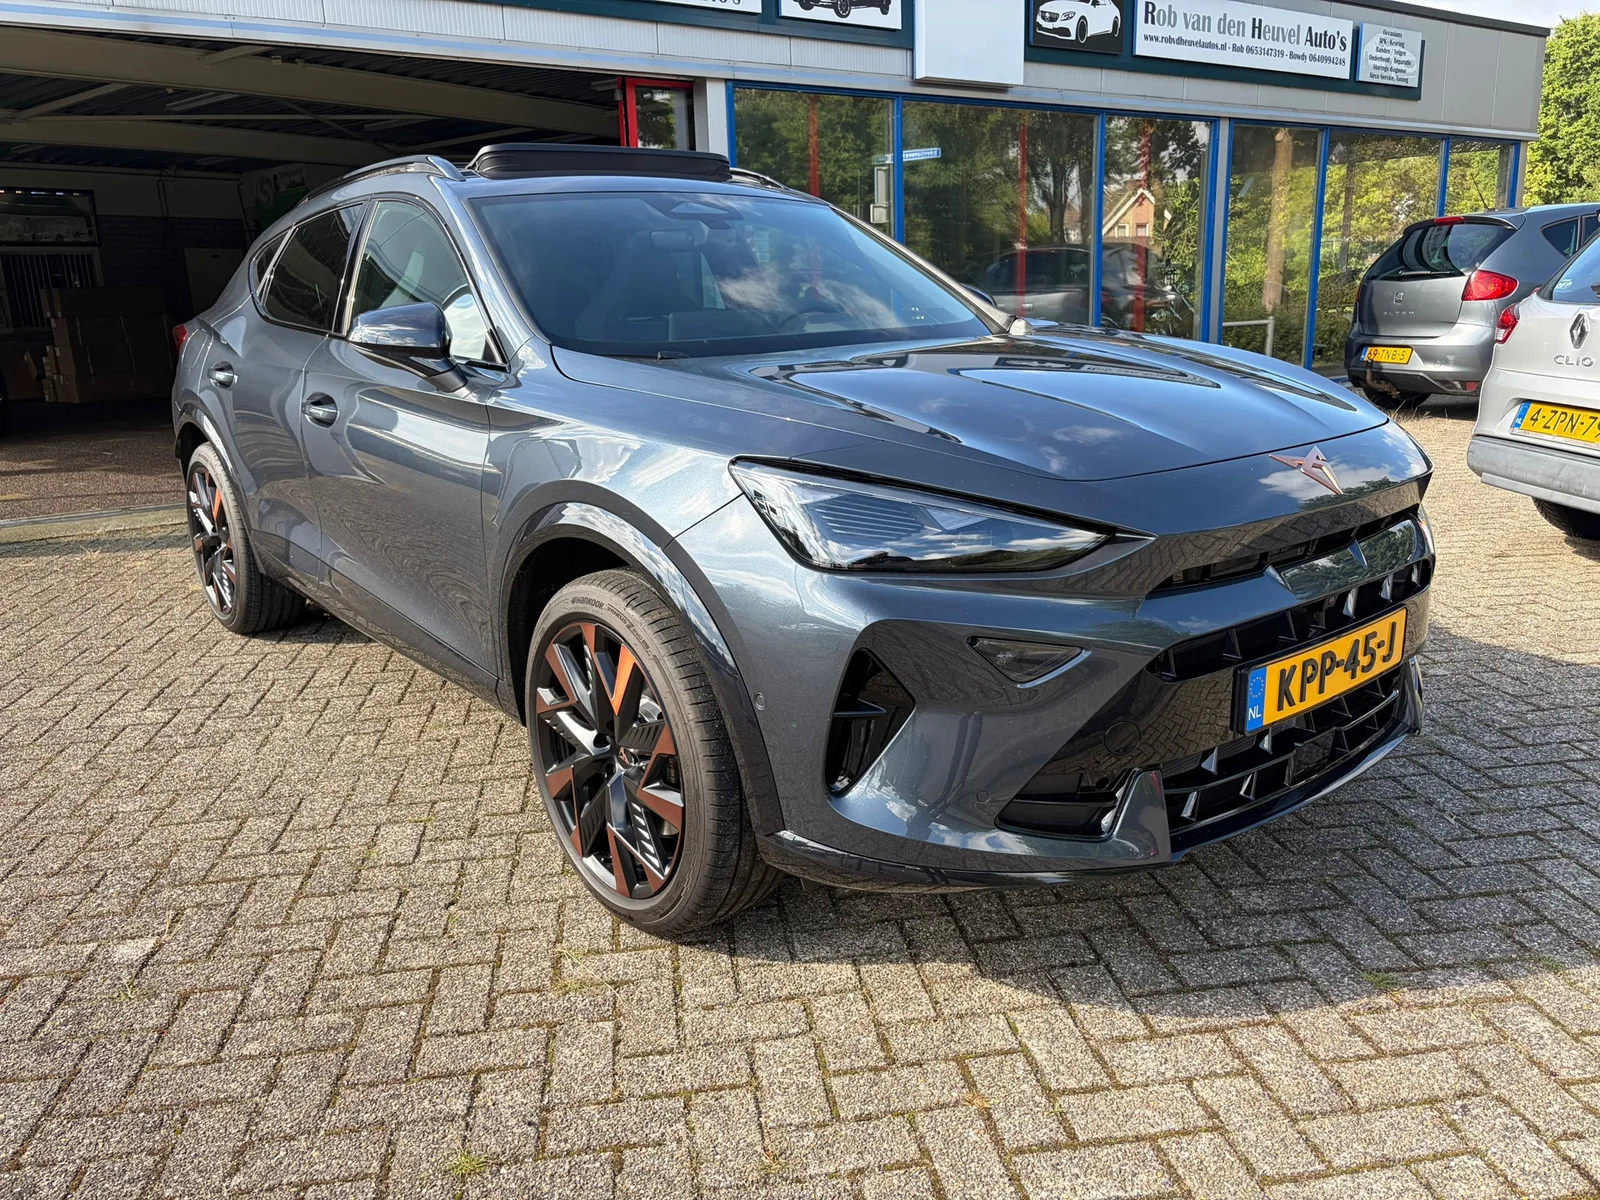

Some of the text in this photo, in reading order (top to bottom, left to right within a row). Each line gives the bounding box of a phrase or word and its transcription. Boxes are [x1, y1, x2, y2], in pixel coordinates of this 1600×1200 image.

[1144, 1, 1347, 51] Rob van den Heuvel Auto's
[1382, 29, 1403, 38] Occasions
[1143, 33, 1227, 51] www.robvdheuvelautos.nl
[1232, 43, 1244, 53] Rob
[1245, 45, 1284, 58] 0653147319
[1553, 355, 1594, 367] CLIO
[1277, 621, 1397, 712] KPP-45-J
[1248, 705, 1261, 721] NL
